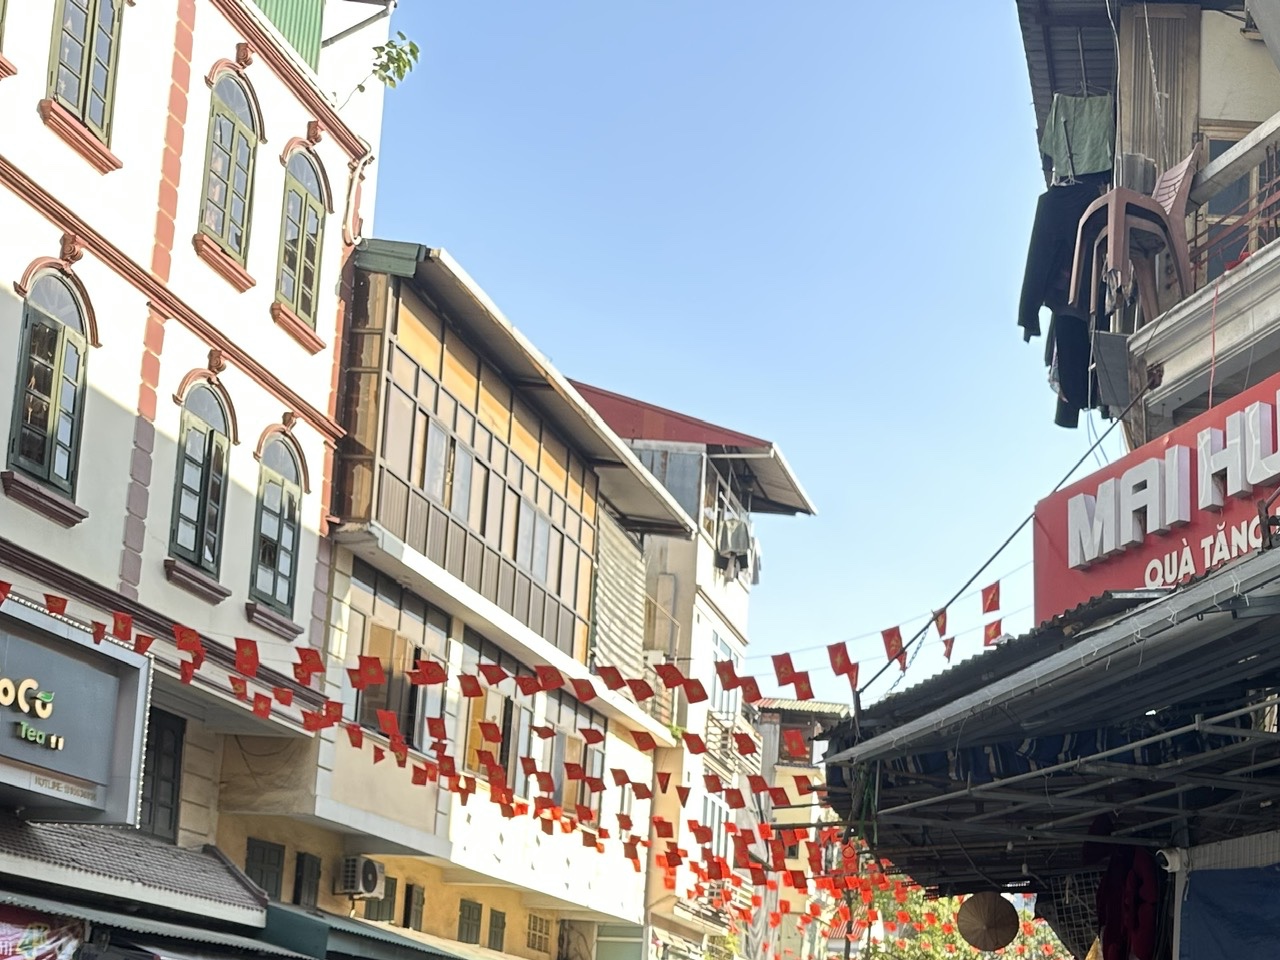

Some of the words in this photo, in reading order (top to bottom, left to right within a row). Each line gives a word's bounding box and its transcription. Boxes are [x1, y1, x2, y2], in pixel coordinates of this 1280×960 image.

[1067, 445, 1191, 570] MAI
[1144, 537, 1196, 589] QUÀ
[20, 721, 45, 745] Tea
